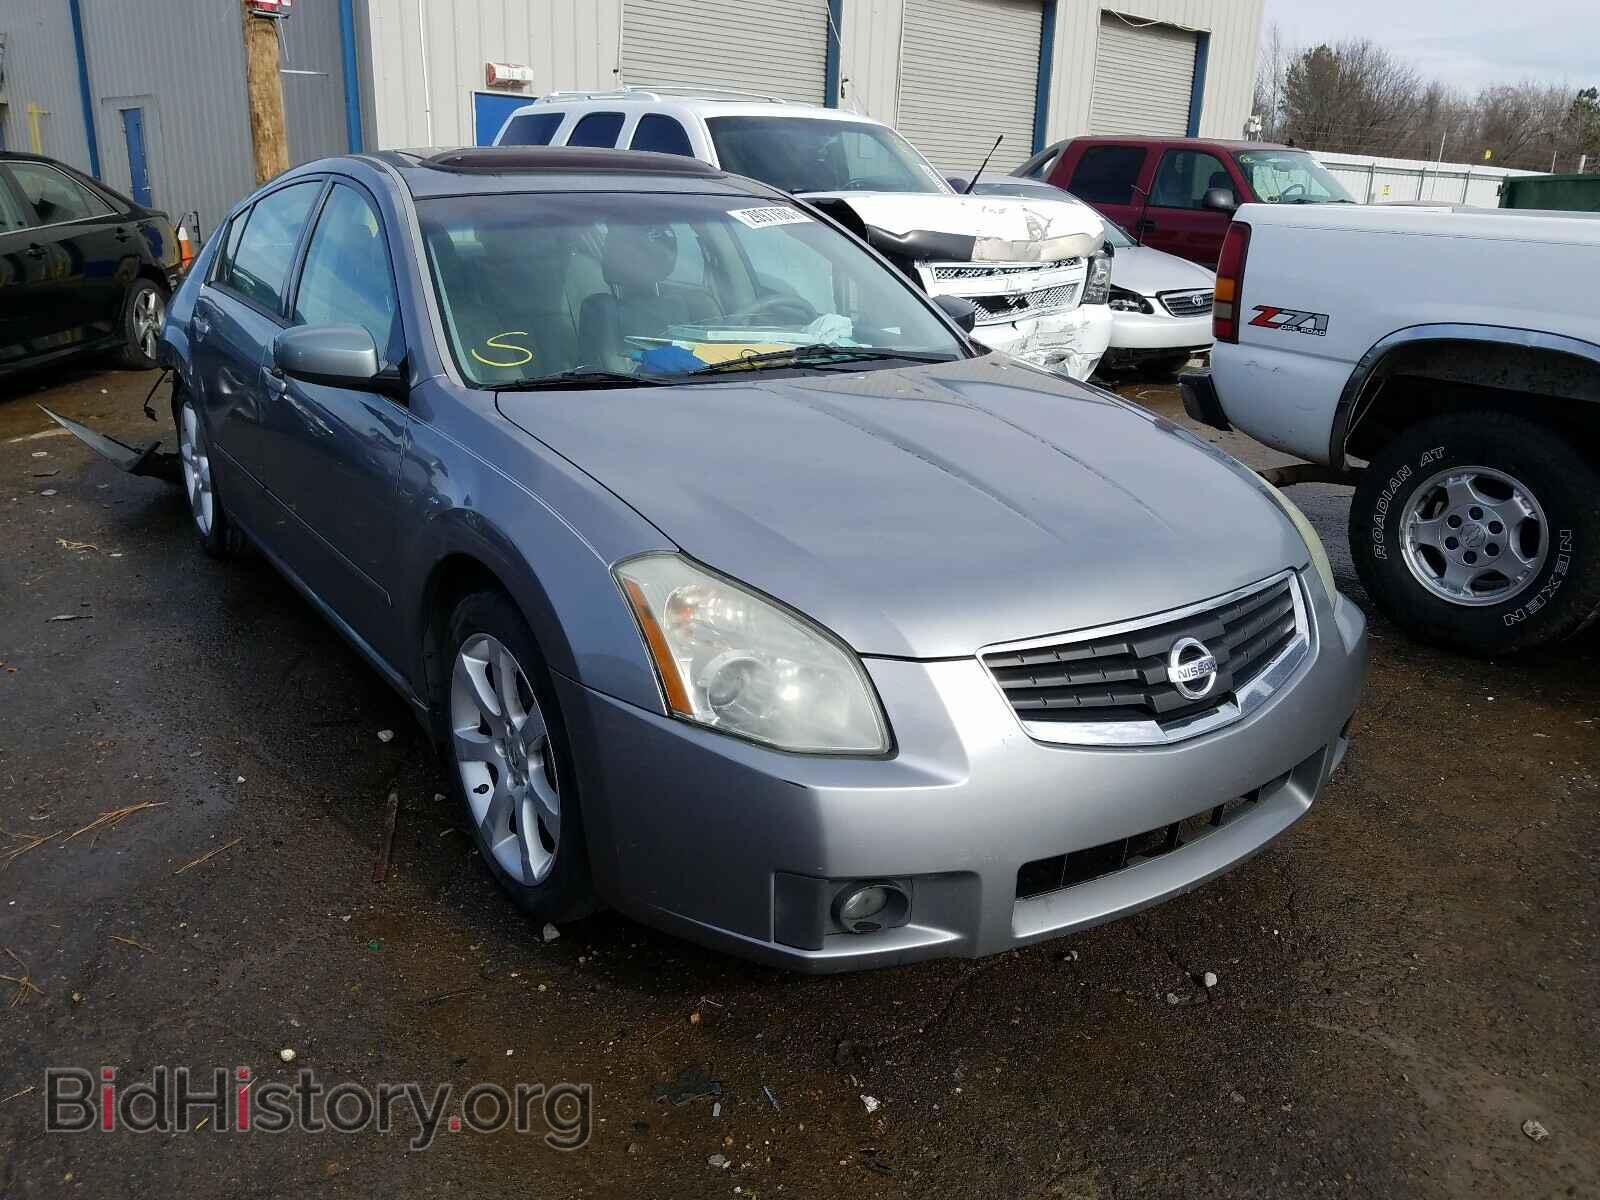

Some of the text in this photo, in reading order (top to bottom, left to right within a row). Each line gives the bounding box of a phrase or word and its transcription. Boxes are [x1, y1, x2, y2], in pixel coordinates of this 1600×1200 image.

[1248, 305, 1329, 330] Z71
[1281, 324, 1327, 336] OFF ROAD
[471, 331, 533, 367] S
[1372, 446, 1445, 560] ROADIAN AT
[1503, 529, 1572, 626] NEXEN
[1178, 659, 1216, 679] NISSAN
